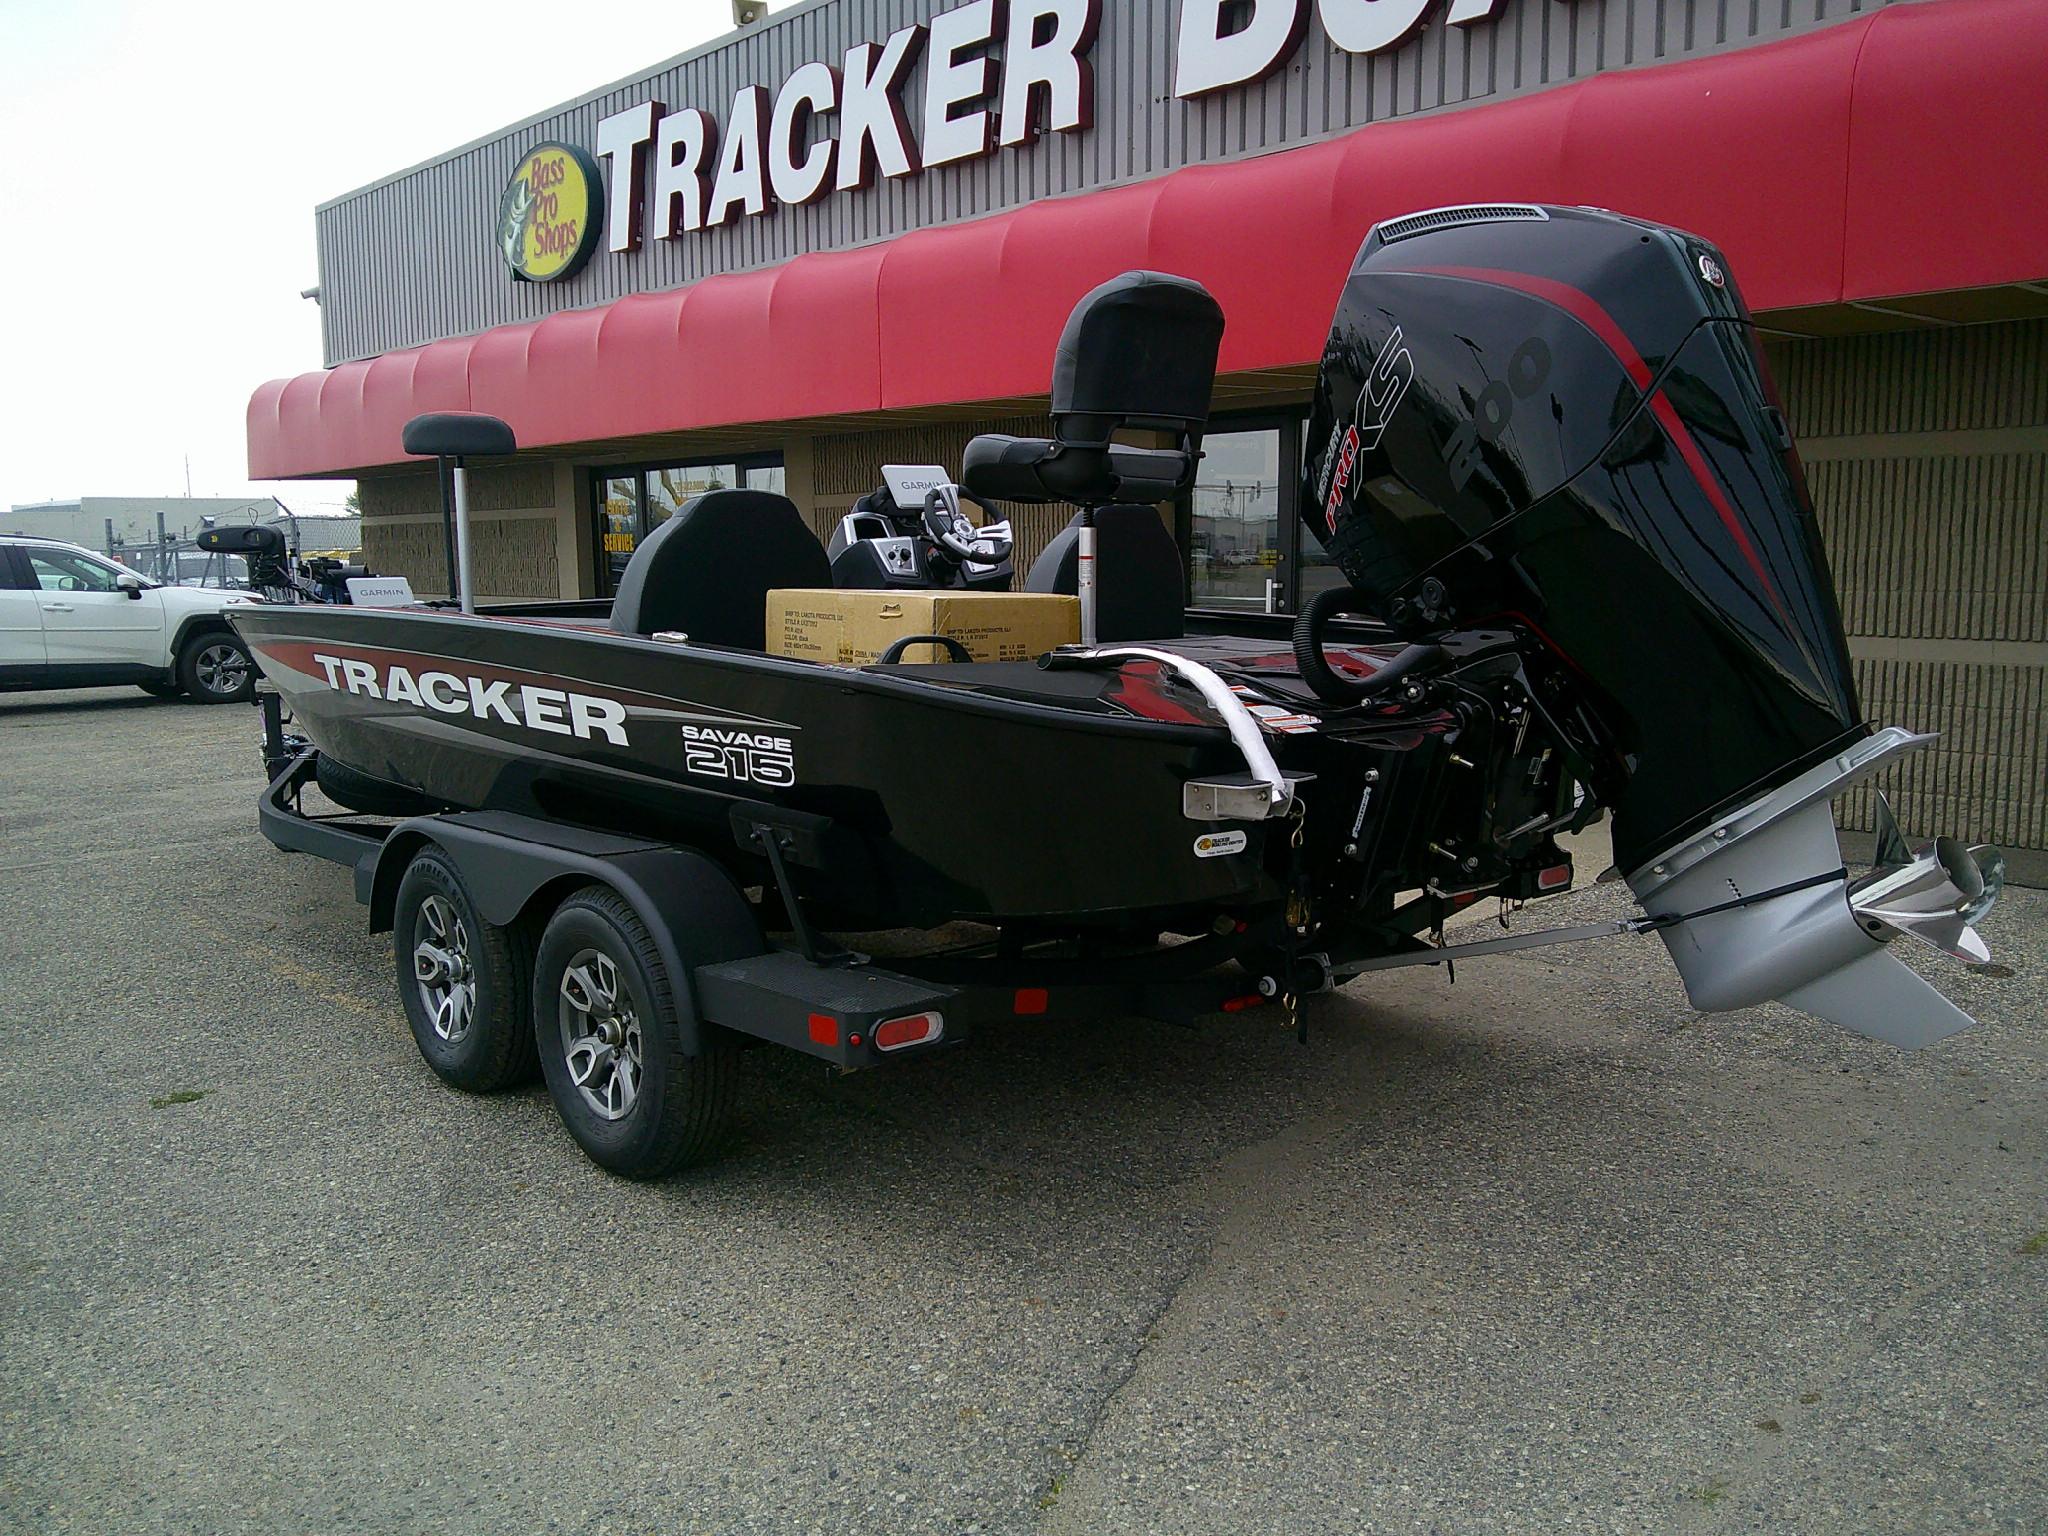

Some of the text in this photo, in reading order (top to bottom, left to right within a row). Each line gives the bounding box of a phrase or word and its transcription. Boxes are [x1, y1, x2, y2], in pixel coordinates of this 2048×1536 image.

[597, 0, 1093, 254] TRACKER
[530, 157, 565, 192] Bass
[530, 190, 558, 225] Pro
[533, 219, 578, 259] Shops
[1325, 325, 1414, 536] PRO XS
[1317, 418, 1341, 506] MERCURY
[603, 533, 634, 551] SERVICE
[360, 588, 404, 597] GARMIN
[313, 652, 630, 747] TRACKER
[682, 724, 792, 753] SAVAGE
[684, 740, 796, 788] 215
